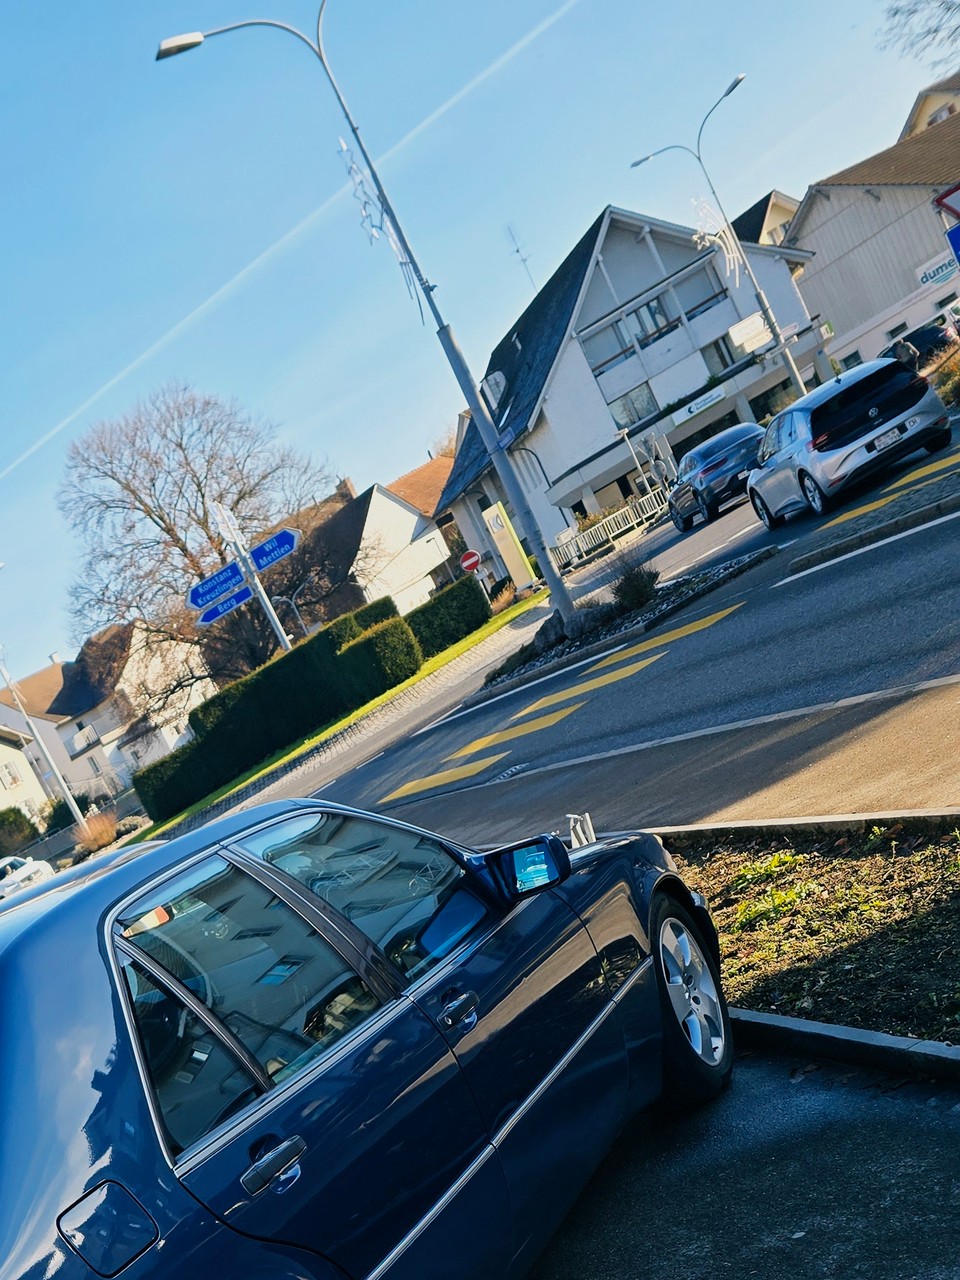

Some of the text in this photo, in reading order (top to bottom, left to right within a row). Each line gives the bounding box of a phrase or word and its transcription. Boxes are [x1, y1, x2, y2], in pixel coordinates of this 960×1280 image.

[258, 544, 291, 567] Mettlen
[263, 537, 278, 552] Wil
[196, 574, 242, 606] Kreuzlingen
[197, 569, 233, 594] Konstanz
[217, 598, 237, 613] Berg
